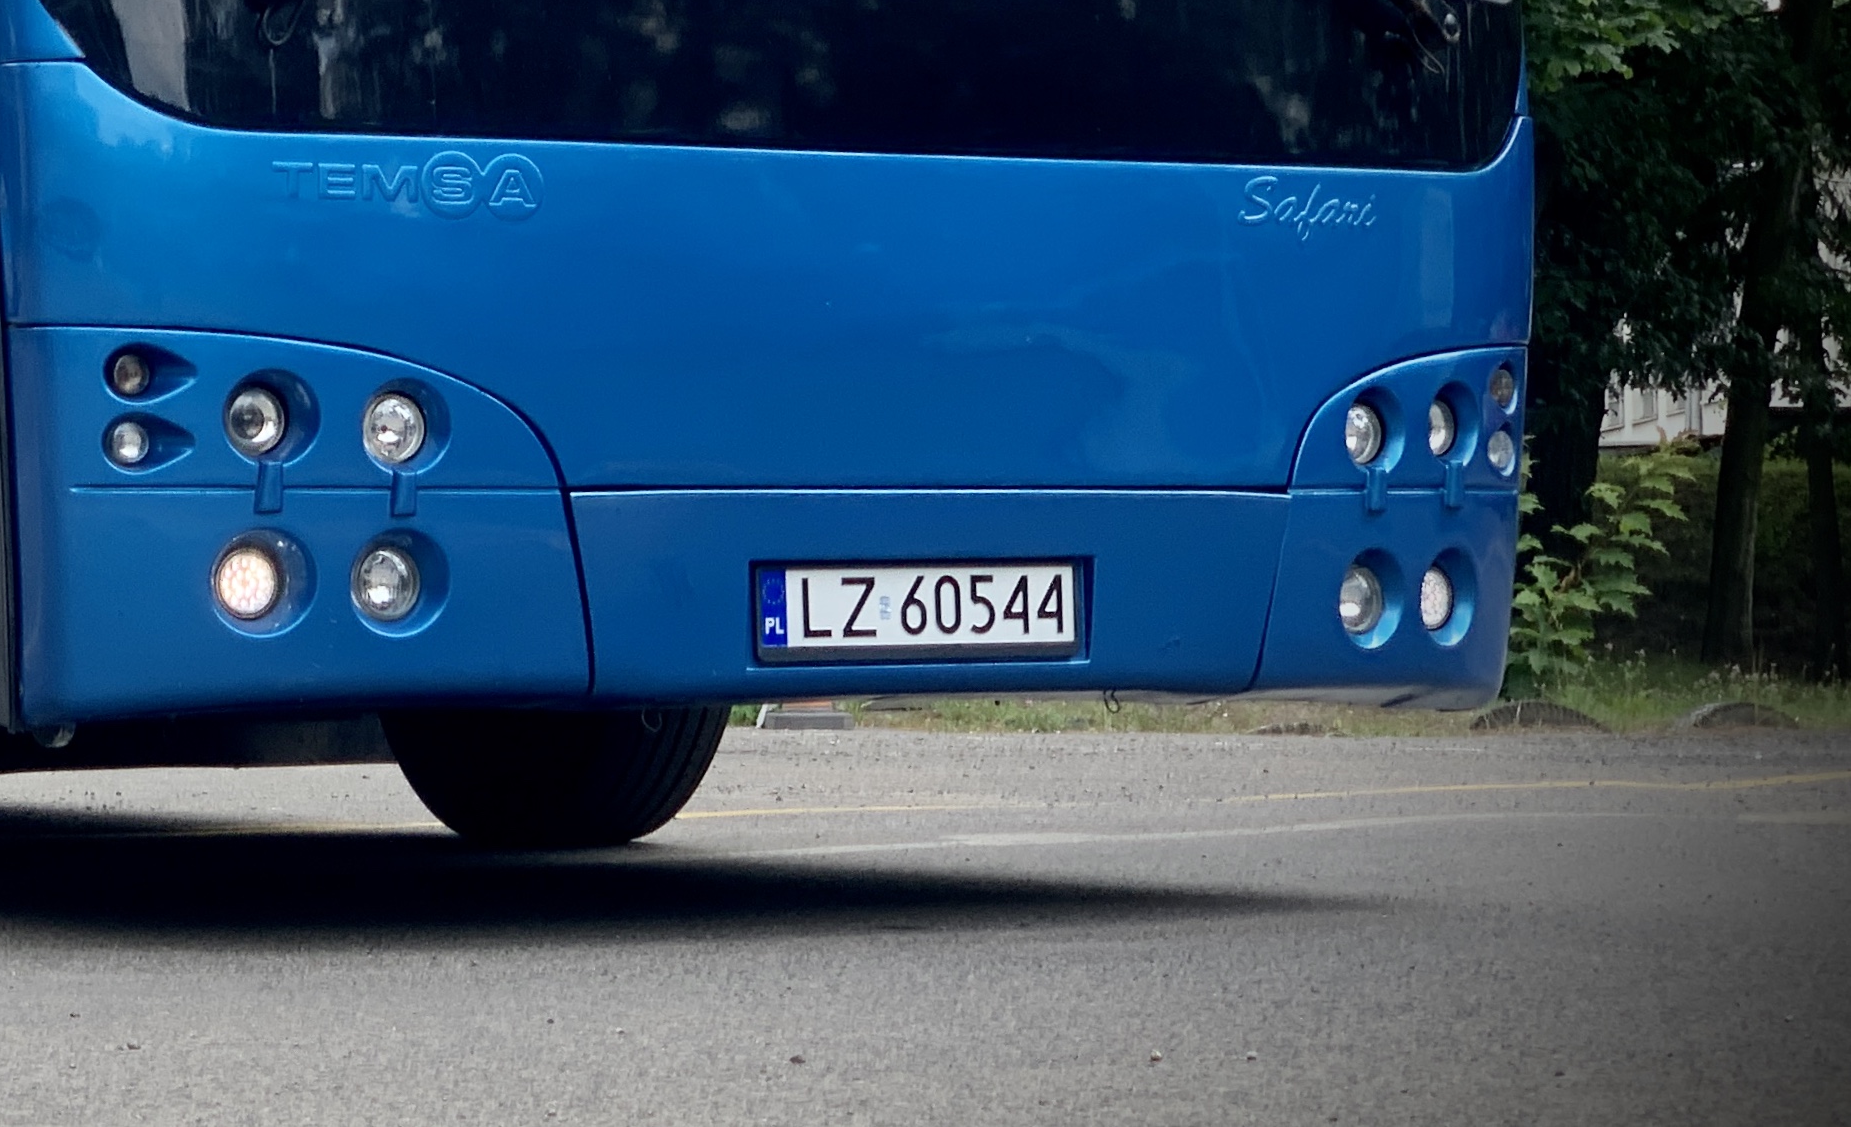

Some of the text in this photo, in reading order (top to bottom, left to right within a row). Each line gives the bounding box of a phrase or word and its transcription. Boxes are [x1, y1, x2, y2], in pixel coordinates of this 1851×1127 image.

[271, 158, 539, 211] TEMSA
[1238, 176, 1377, 241] Safari
[764, 617, 785, 635] PL
[801, 577, 878, 639] LZ
[900, 574, 1065, 636] 60544
